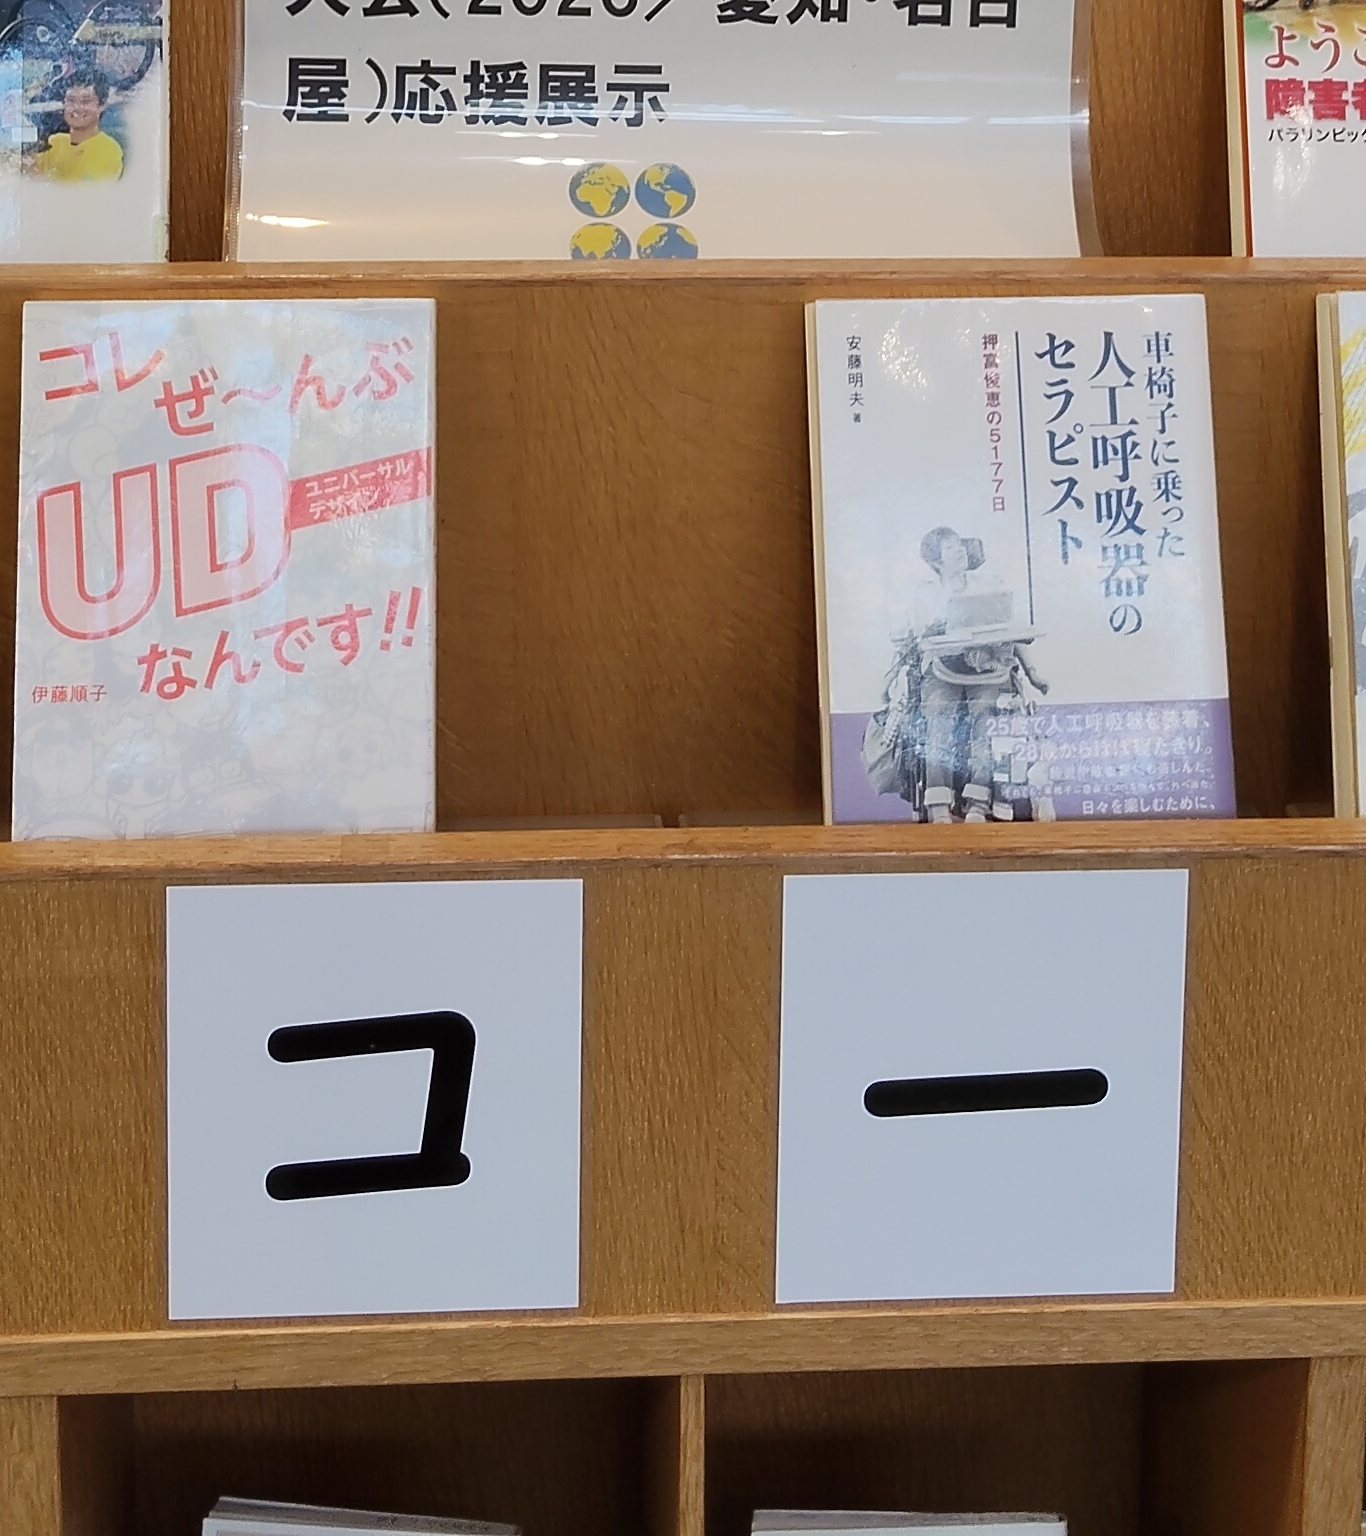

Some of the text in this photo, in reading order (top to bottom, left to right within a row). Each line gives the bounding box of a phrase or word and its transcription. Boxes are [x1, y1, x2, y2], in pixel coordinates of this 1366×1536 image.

[38, 331, 165, 401] コレ
[845, 334, 866, 407] 安藤明夫
[305, 457, 414, 498] ユニバーサル
[1035, 331, 1085, 566] セラピスト
[1087, 330, 1150, 636] 人工呼吸器の
[1140, 331, 1185, 558] 車椅子に乗った
[36, 442, 292, 641] UD
[31, 684, 108, 704] 伊藤順子
